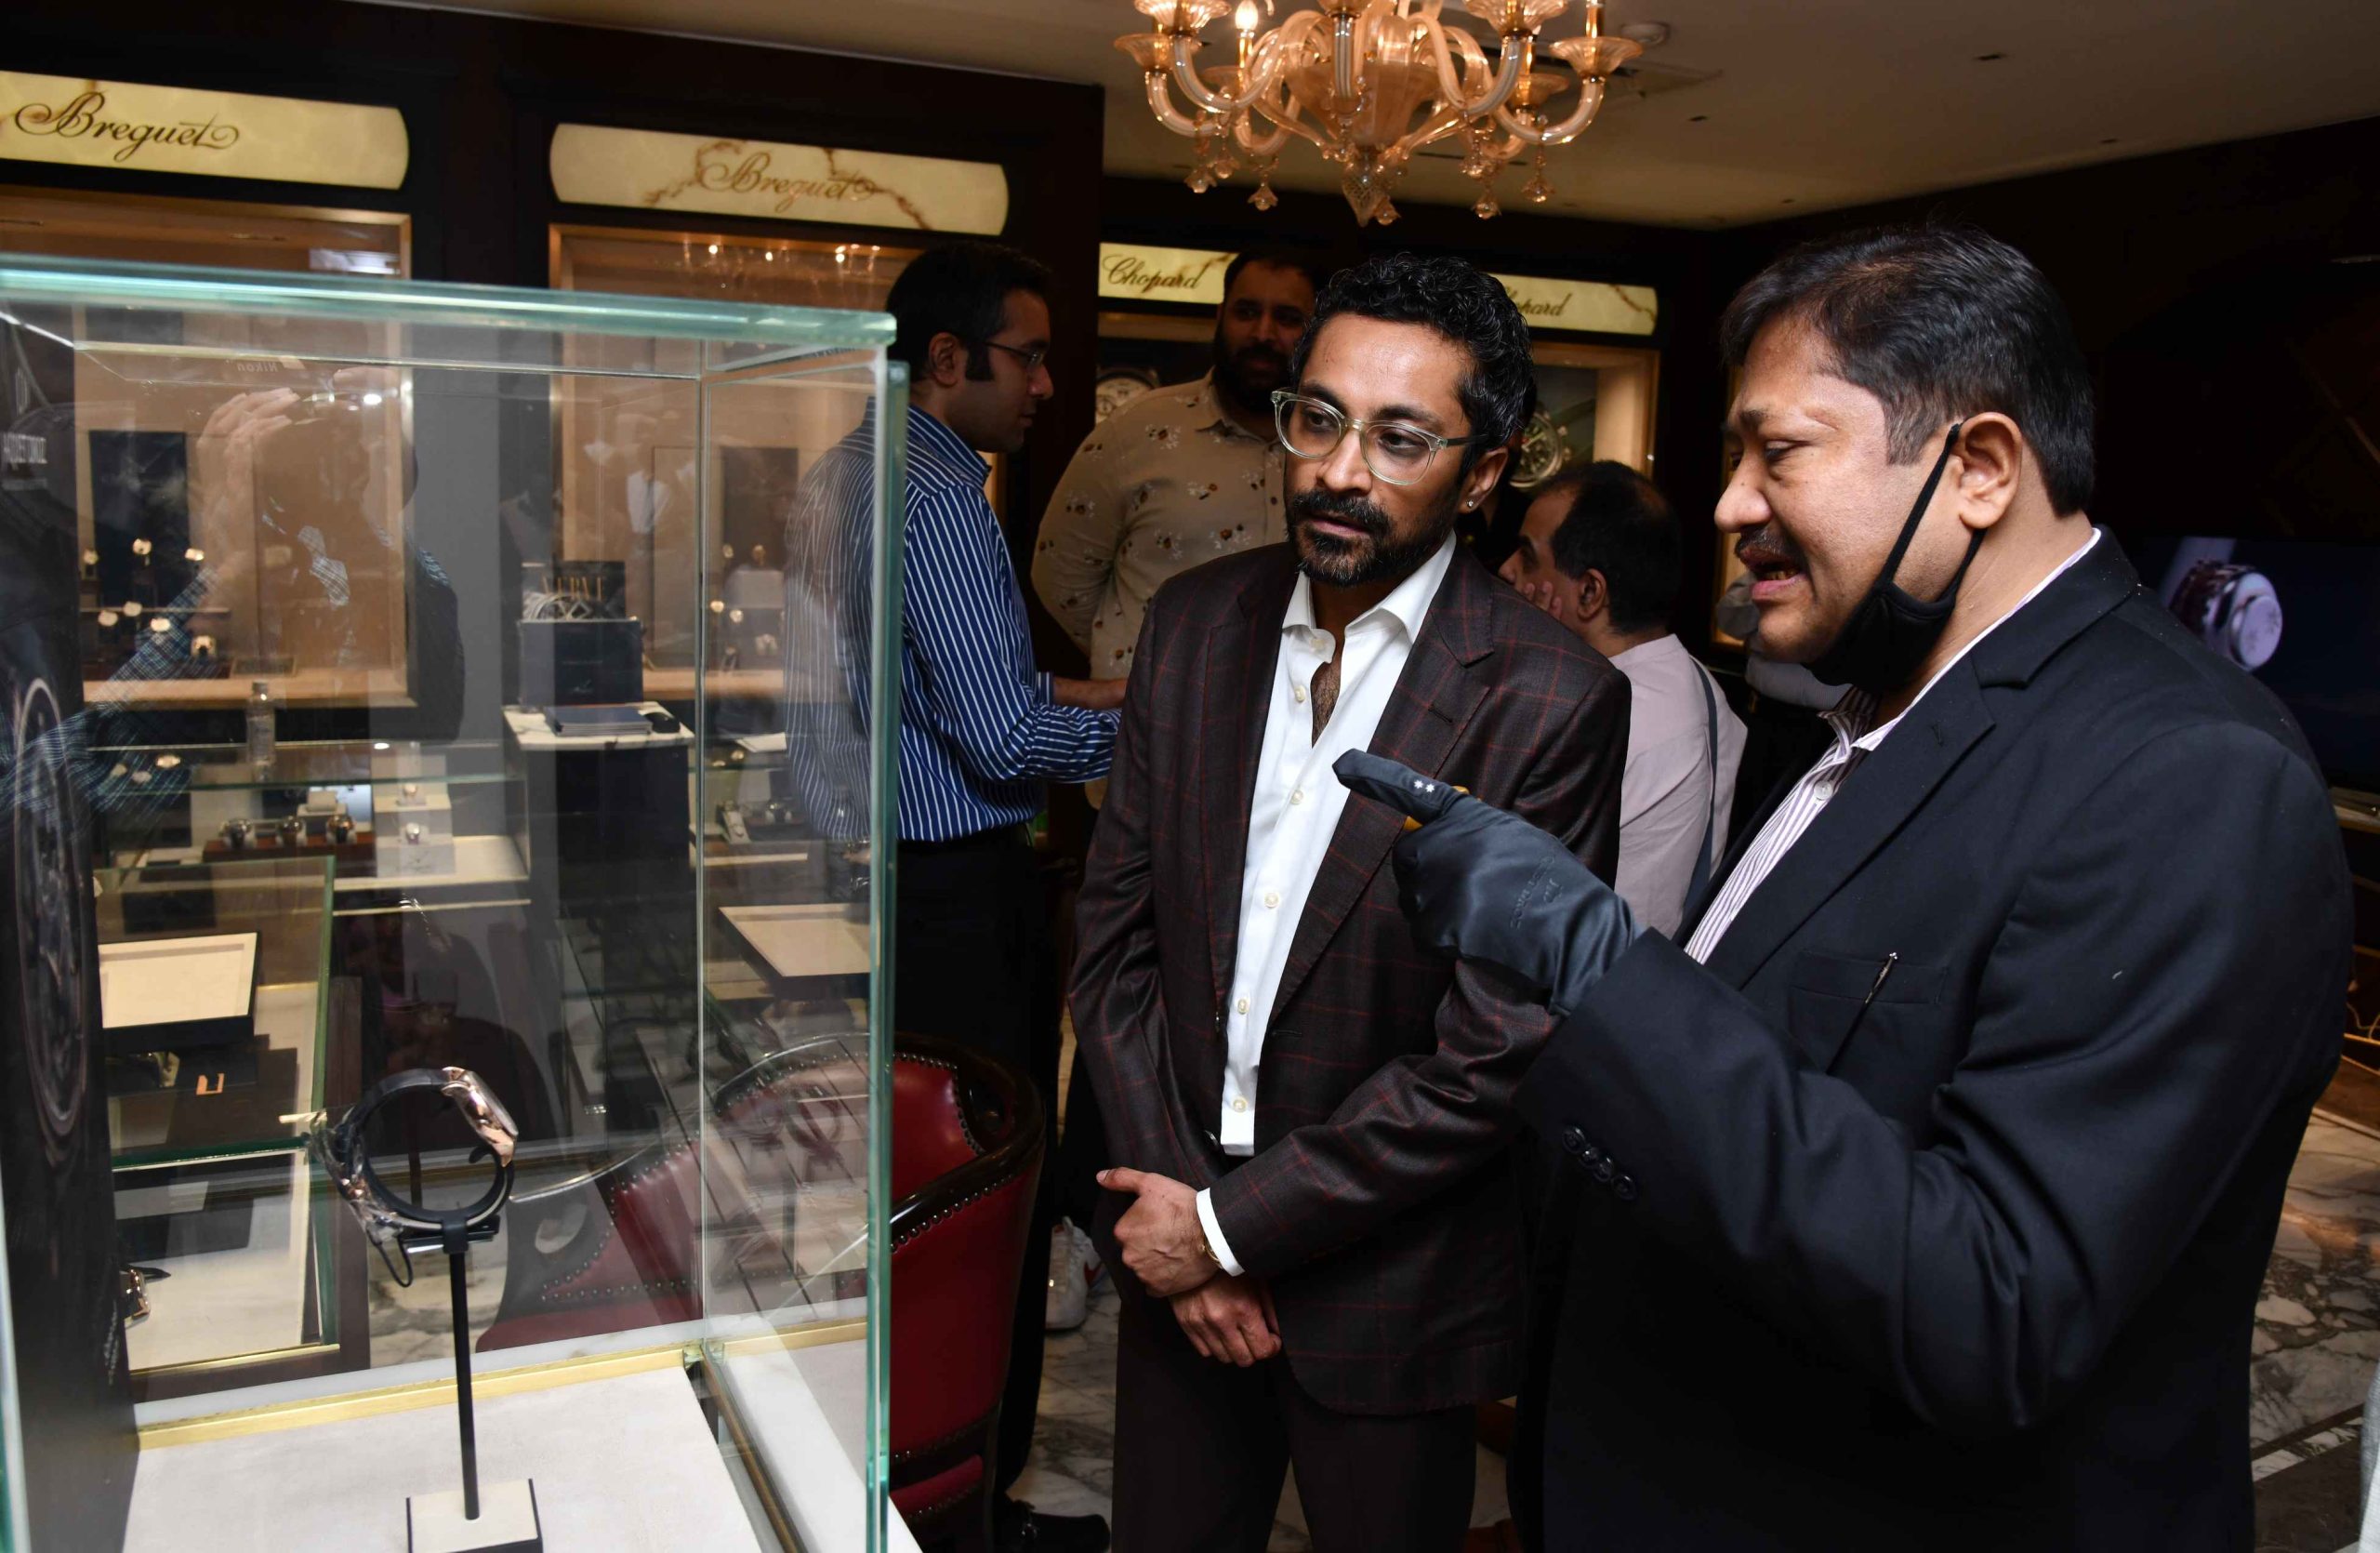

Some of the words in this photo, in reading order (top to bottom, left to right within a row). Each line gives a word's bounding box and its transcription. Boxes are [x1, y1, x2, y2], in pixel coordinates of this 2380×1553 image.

[15, 91, 240, 162] Breguet
[700, 151, 877, 213] Breguet
[1102, 253, 1212, 293] Chopard
